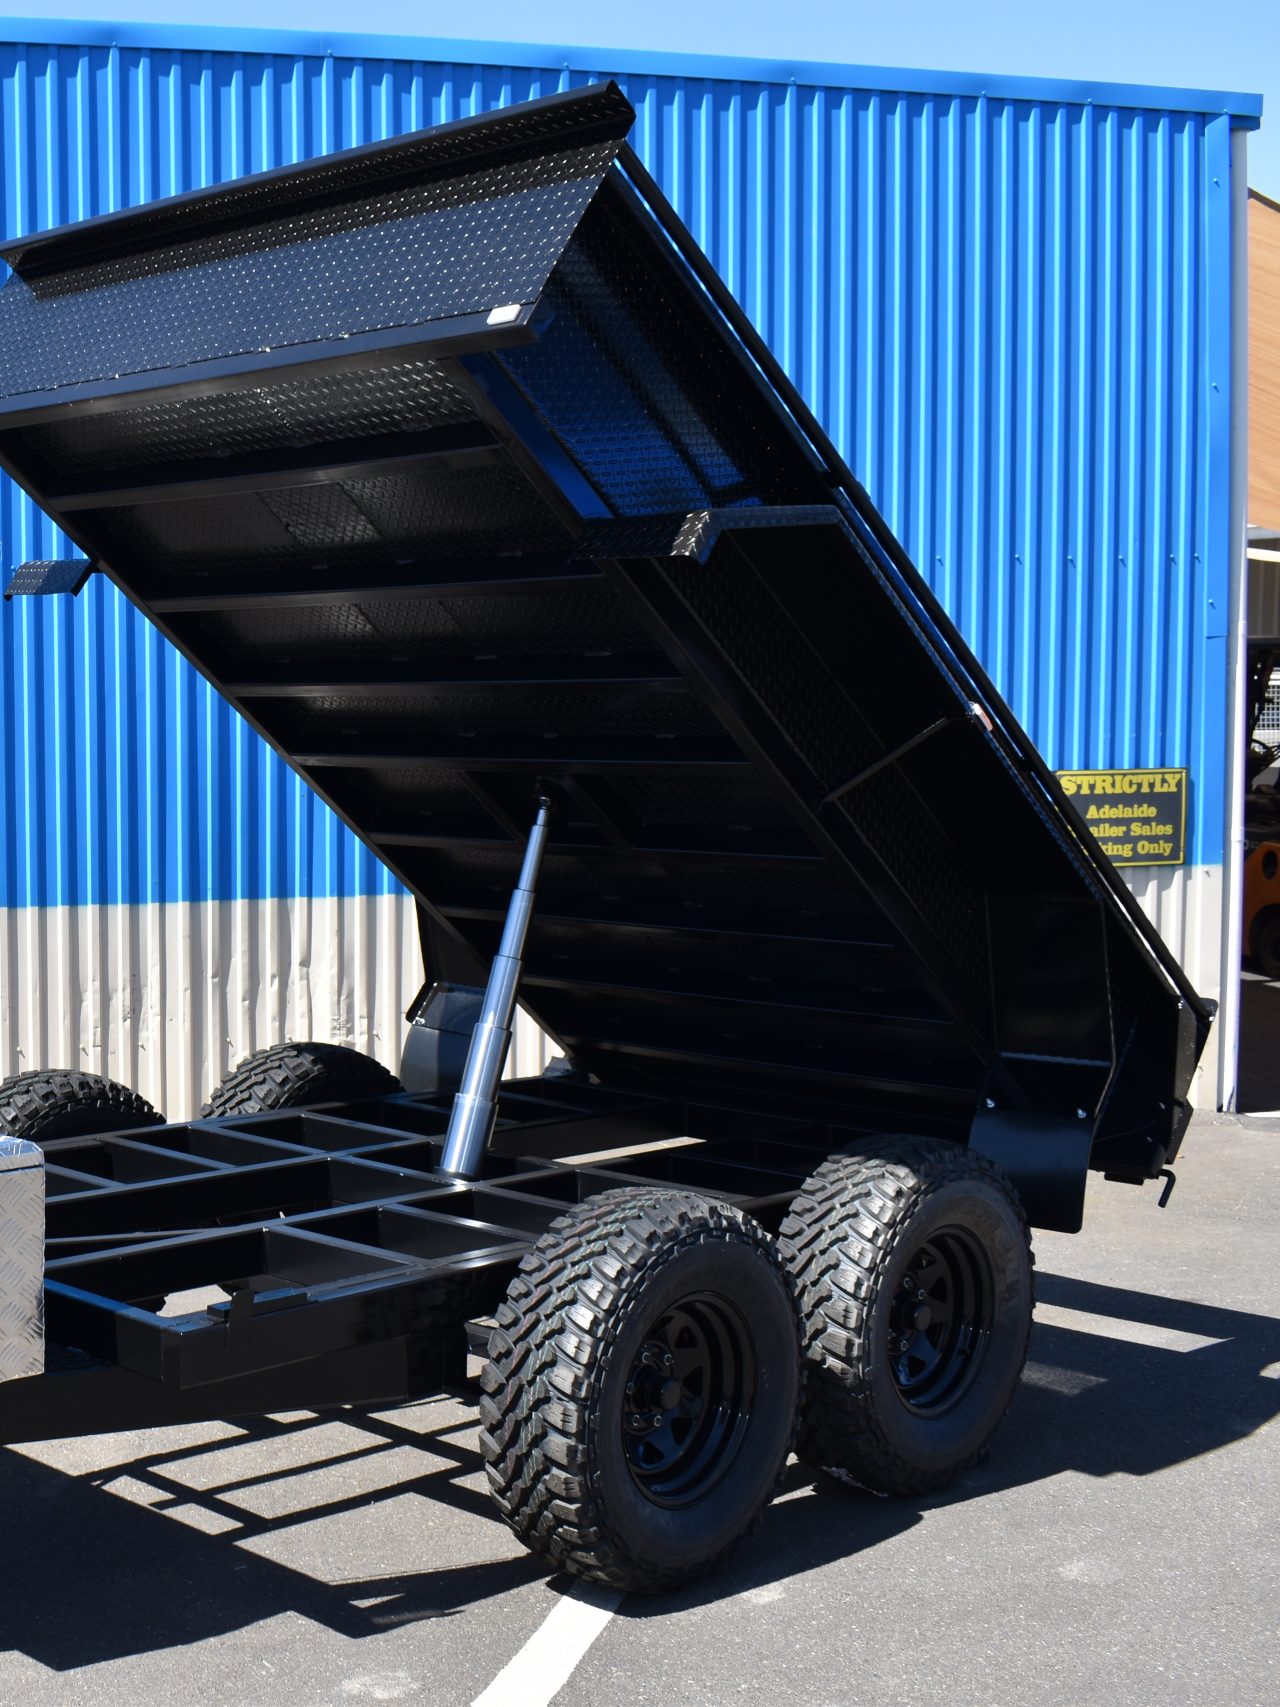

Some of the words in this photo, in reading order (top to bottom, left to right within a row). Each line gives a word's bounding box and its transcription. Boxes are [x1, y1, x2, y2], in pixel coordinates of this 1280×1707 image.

[1060, 773, 1181, 795] STRICTLY
[1086, 803, 1157, 818] Adelaide
[1090, 823, 1126, 837] ailer
[1130, 822, 1173, 836] Sales
[1099, 842, 1133, 857] king
[1137, 840, 1173, 856] Only
